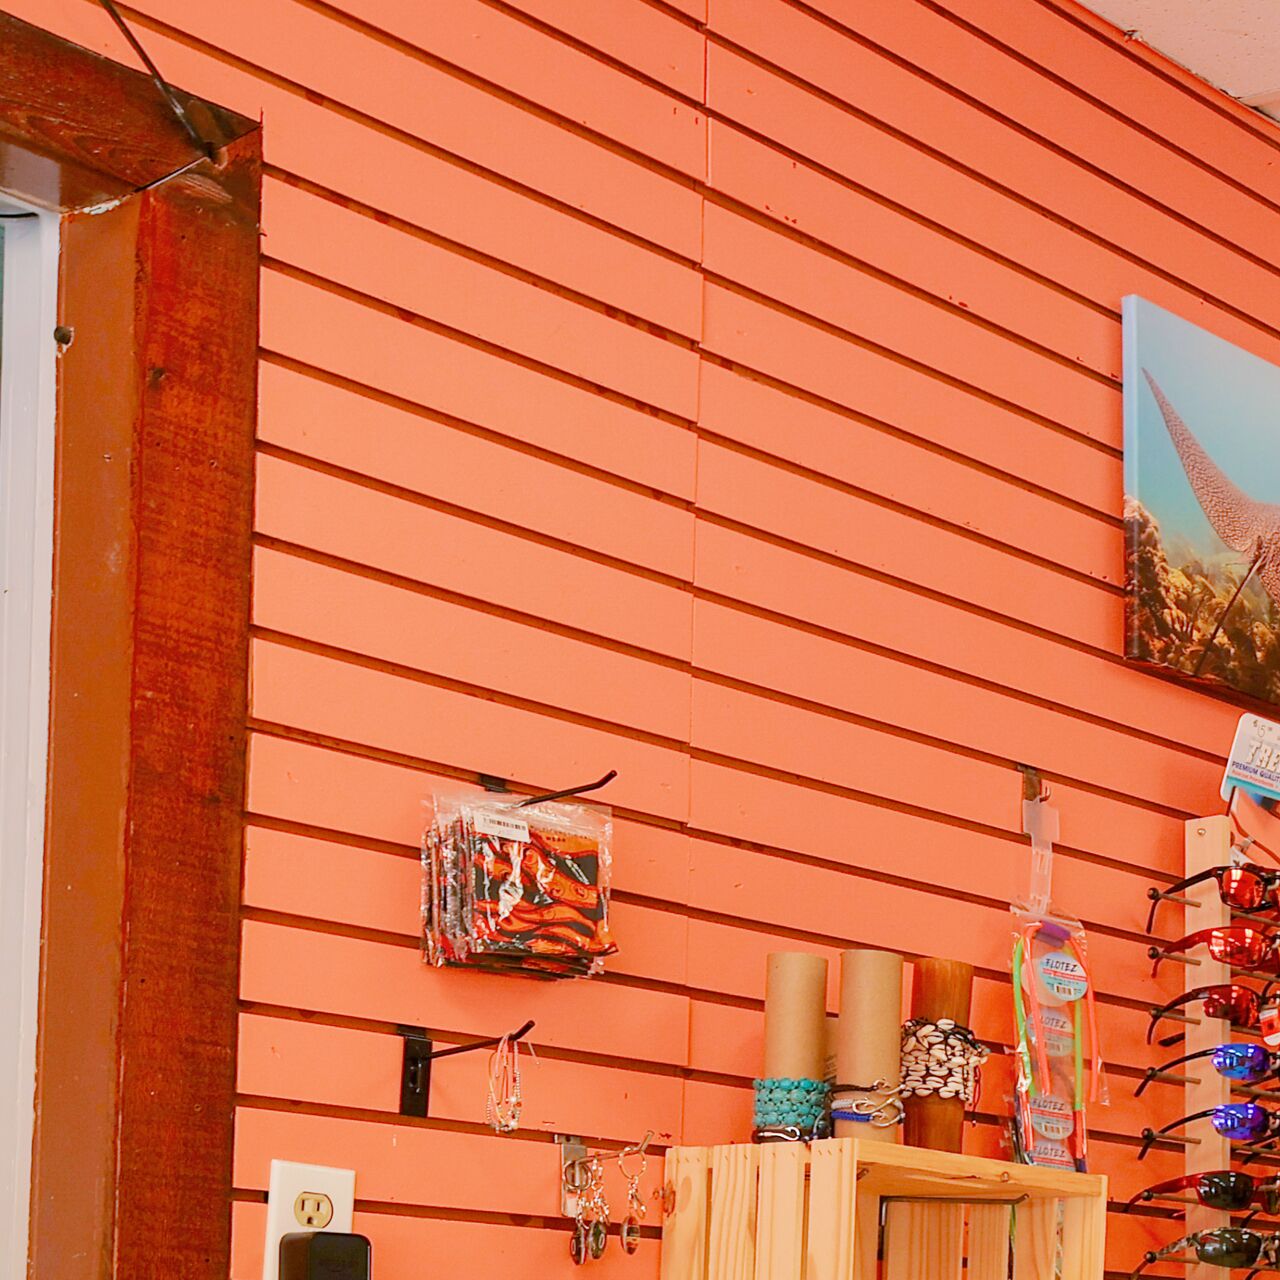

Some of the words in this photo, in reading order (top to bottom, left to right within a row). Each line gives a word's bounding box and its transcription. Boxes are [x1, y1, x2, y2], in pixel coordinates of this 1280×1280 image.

[1232, 761, 1258, 775] PREMIUM
[1045, 958, 1078, 972] FLOTEZ
[1040, 1015, 1067, 1029] LOTEZ
